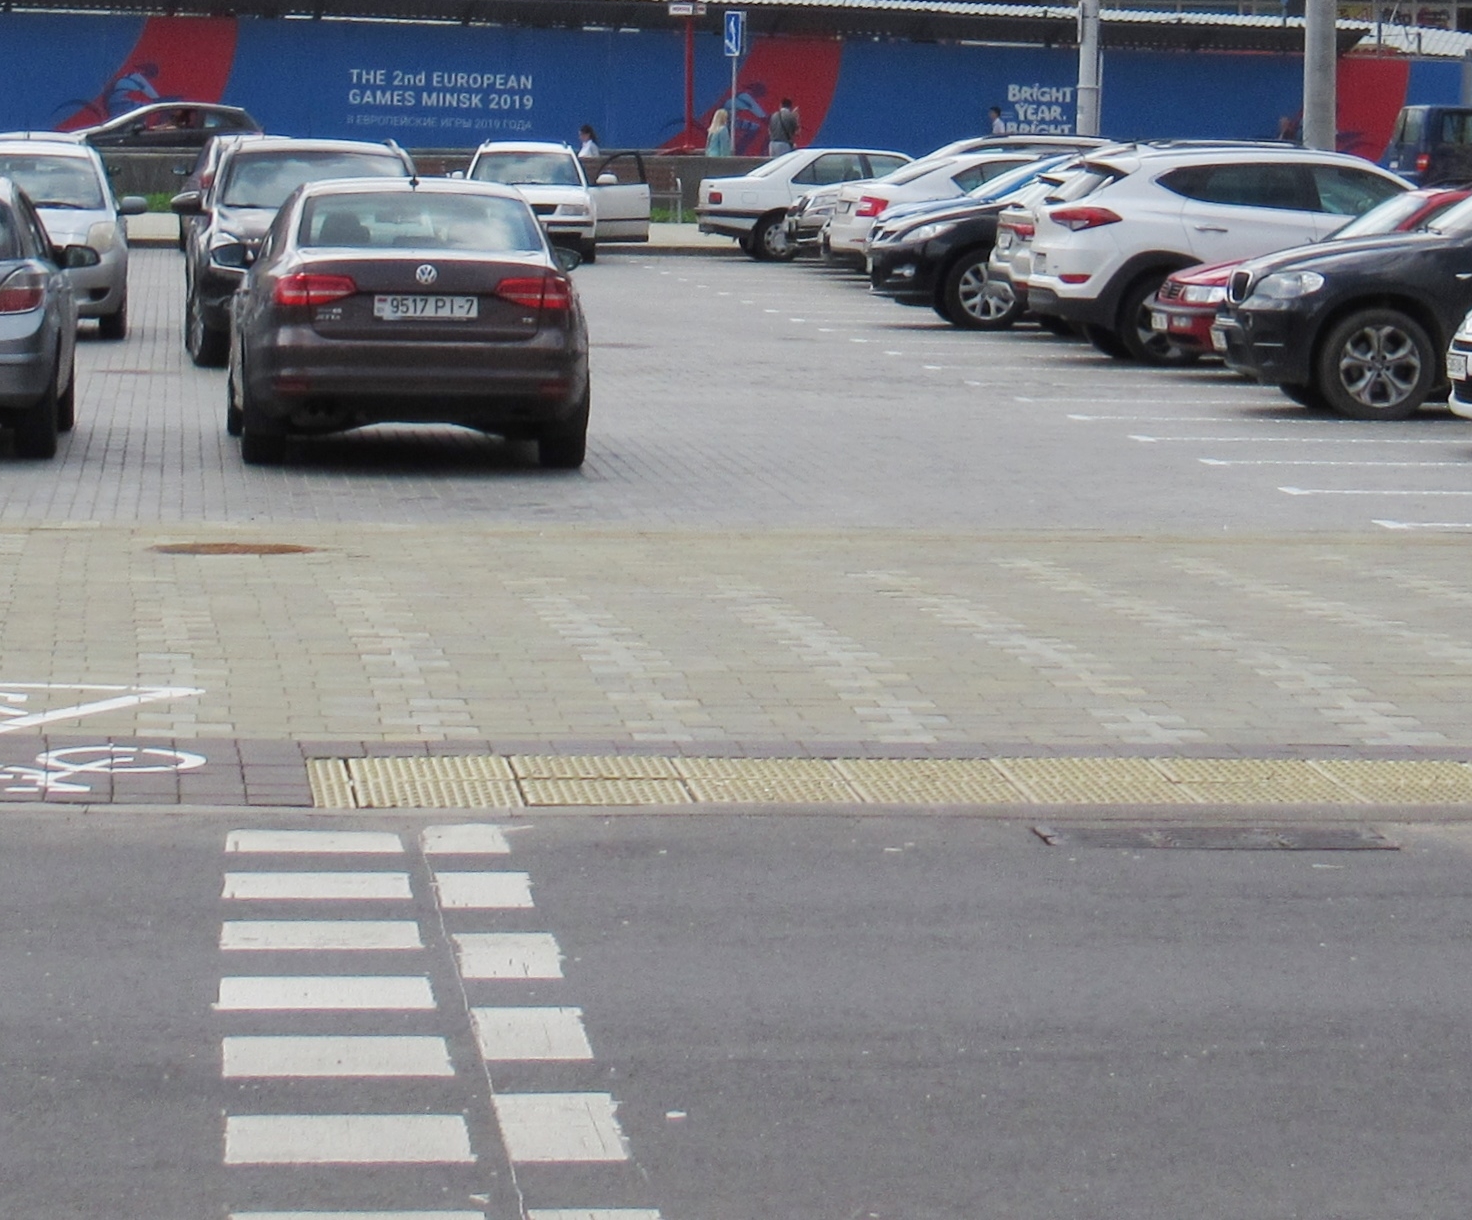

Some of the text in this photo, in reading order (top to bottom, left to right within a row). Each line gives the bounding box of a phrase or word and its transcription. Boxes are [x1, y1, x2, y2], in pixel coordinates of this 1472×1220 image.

[350, 69, 533, 90] THE 2nd EUROPEAN
[349, 89, 534, 110] GAMES MINSK 2019
[1008, 83, 1074, 103] BRIGHT
[441, 119, 472, 128] ИГРЫ
[475, 120, 501, 129] 2019
[390, 297, 428, 315] 9517
